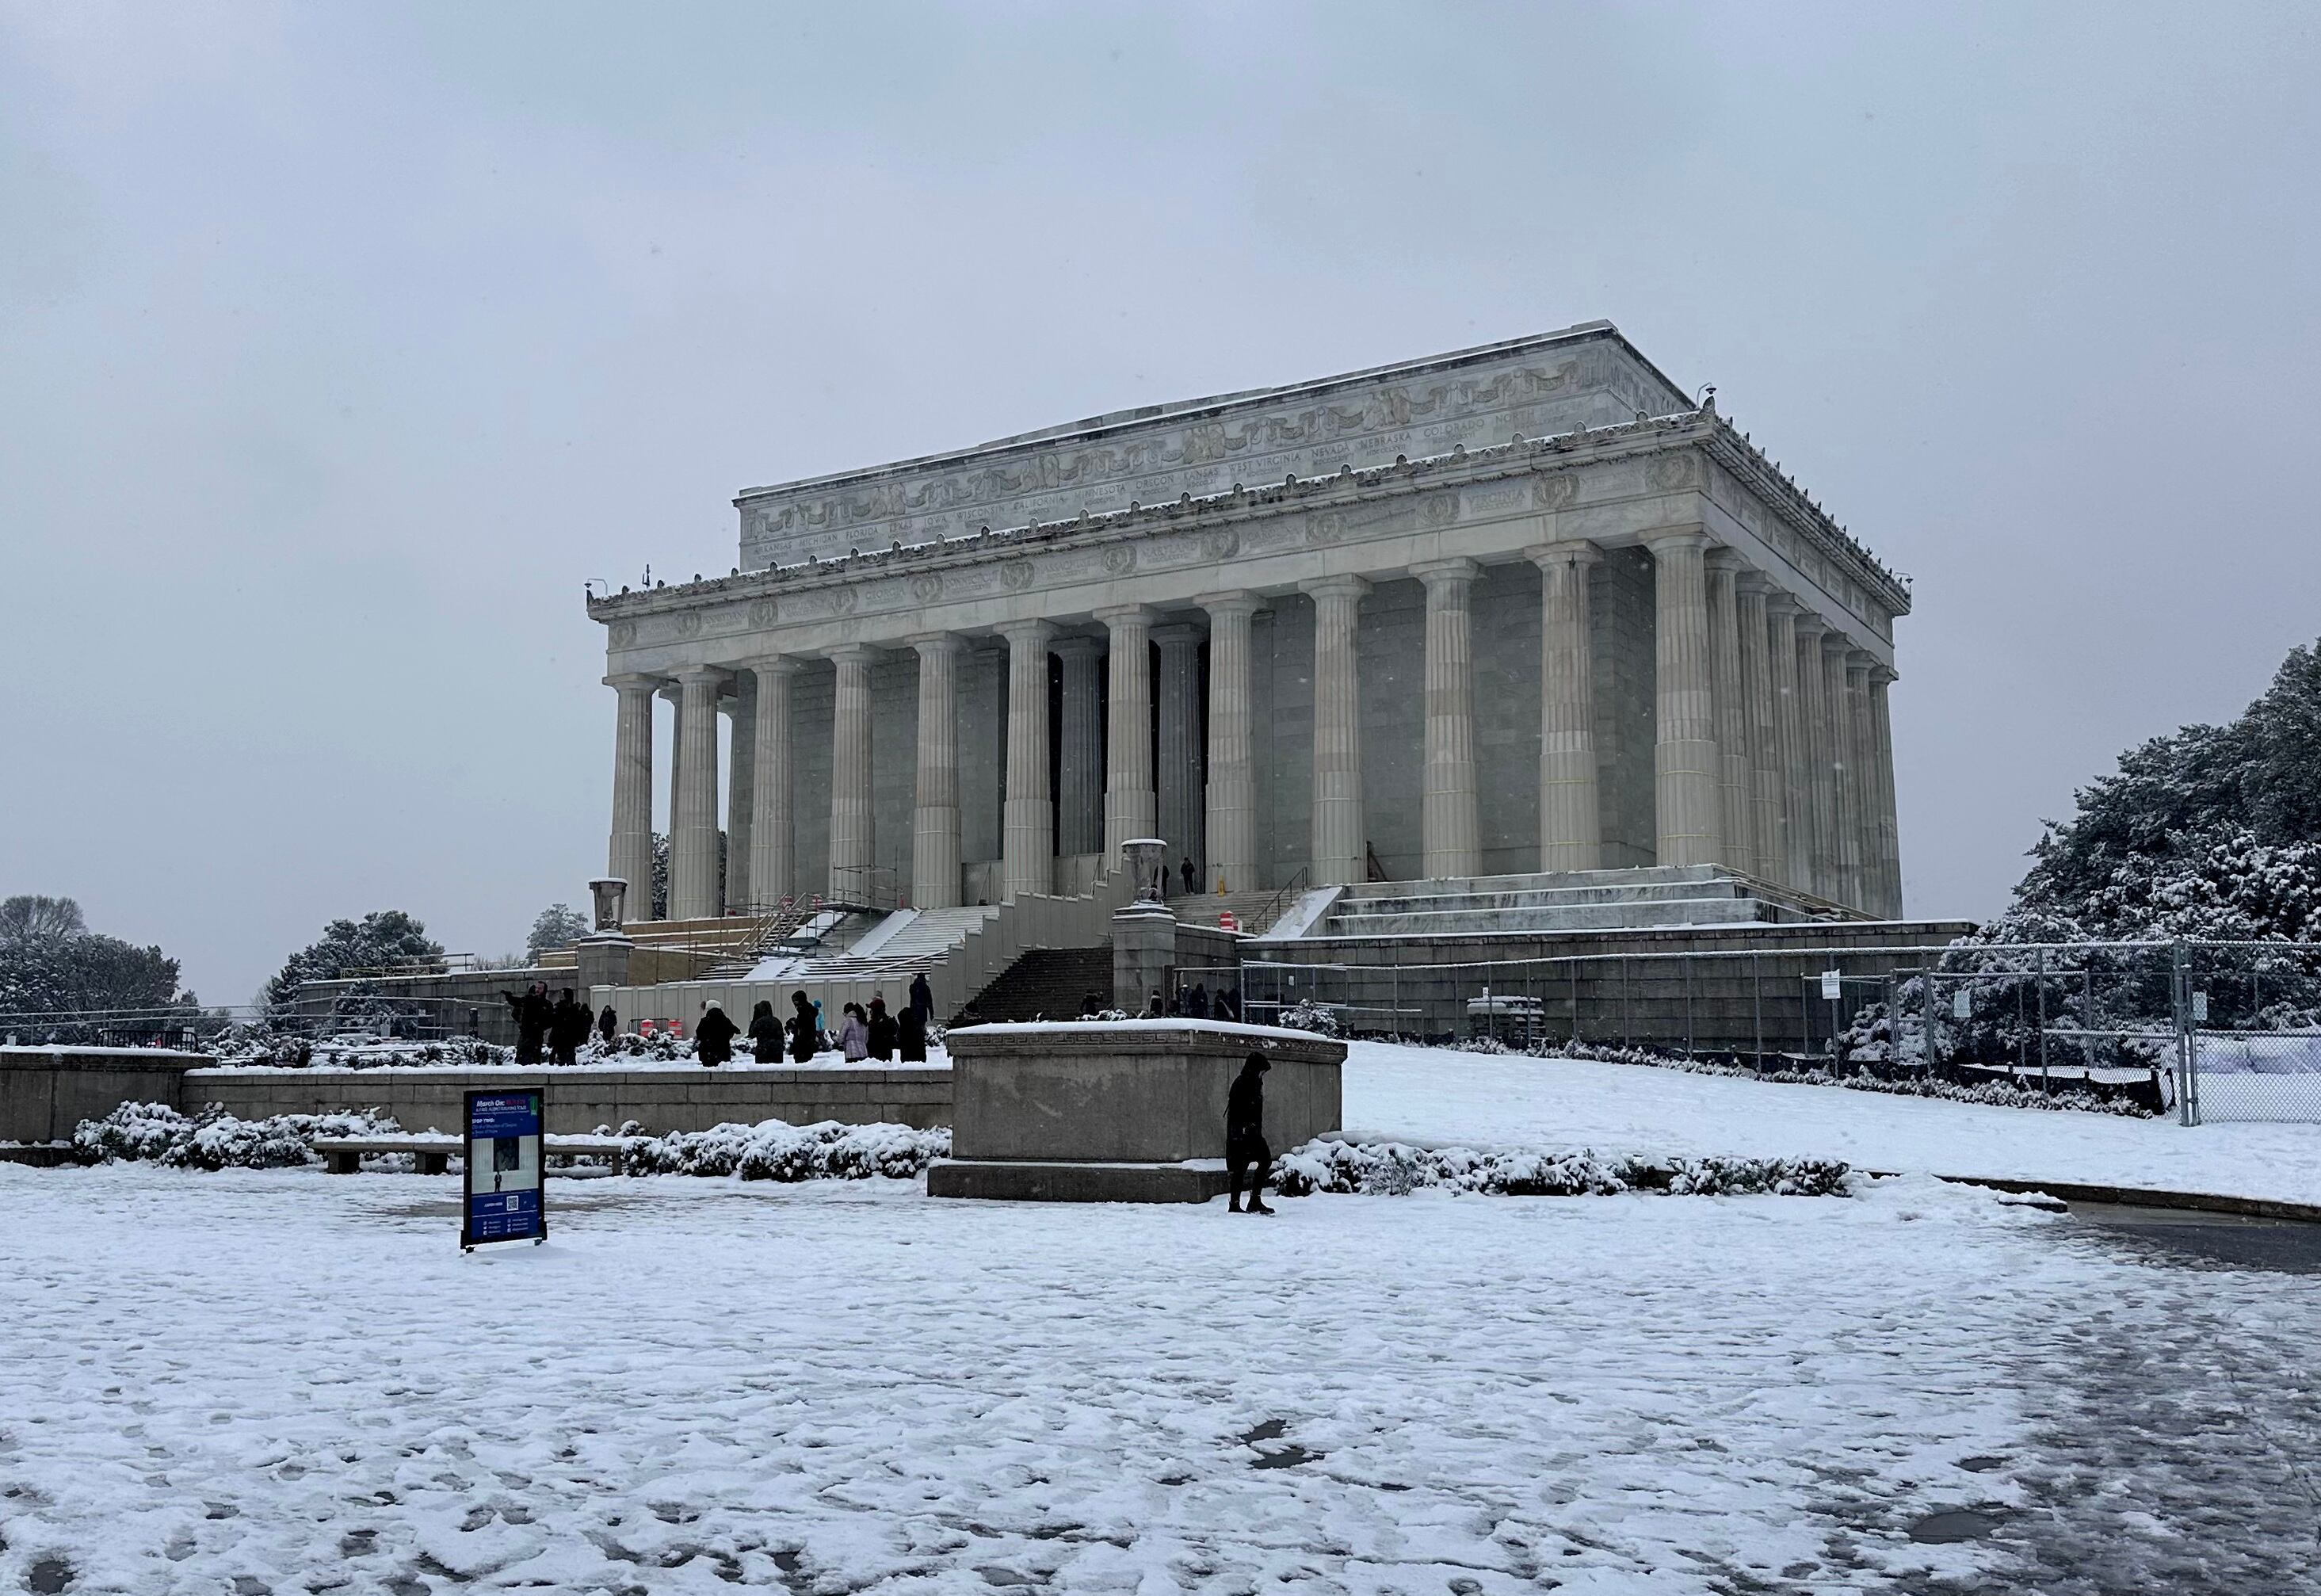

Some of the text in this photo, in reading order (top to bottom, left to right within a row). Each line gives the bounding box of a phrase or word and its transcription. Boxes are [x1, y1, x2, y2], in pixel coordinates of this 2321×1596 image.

[1496, 409, 1534, 424] NORTH
[1424, 418, 1485, 437] COLORADO
[1360, 433, 1411, 449] NEBRASKA
[1311, 445, 1349, 457] NEVADA
[1229, 452, 1301, 472] WEST VIRGINIA
[1184, 468, 1219, 481] KANSAS
[1136, 476, 1174, 490] OREGON
[1075, 484, 1126, 499] MINNESOTA
[1468, 489, 1525, 506] VIRGINIA
[1014, 495, 1065, 511] CALIFORNIA
[956, 505, 1005, 520] WISCONSIN
[888, 520, 912, 533] TEXAS
[924, 516, 947, 526] IOWA
[799, 533, 838, 547] MICHIGAN
[846, 526, 878, 540] FLORIDA
[754, 540, 792, 554] ARKANSAS
